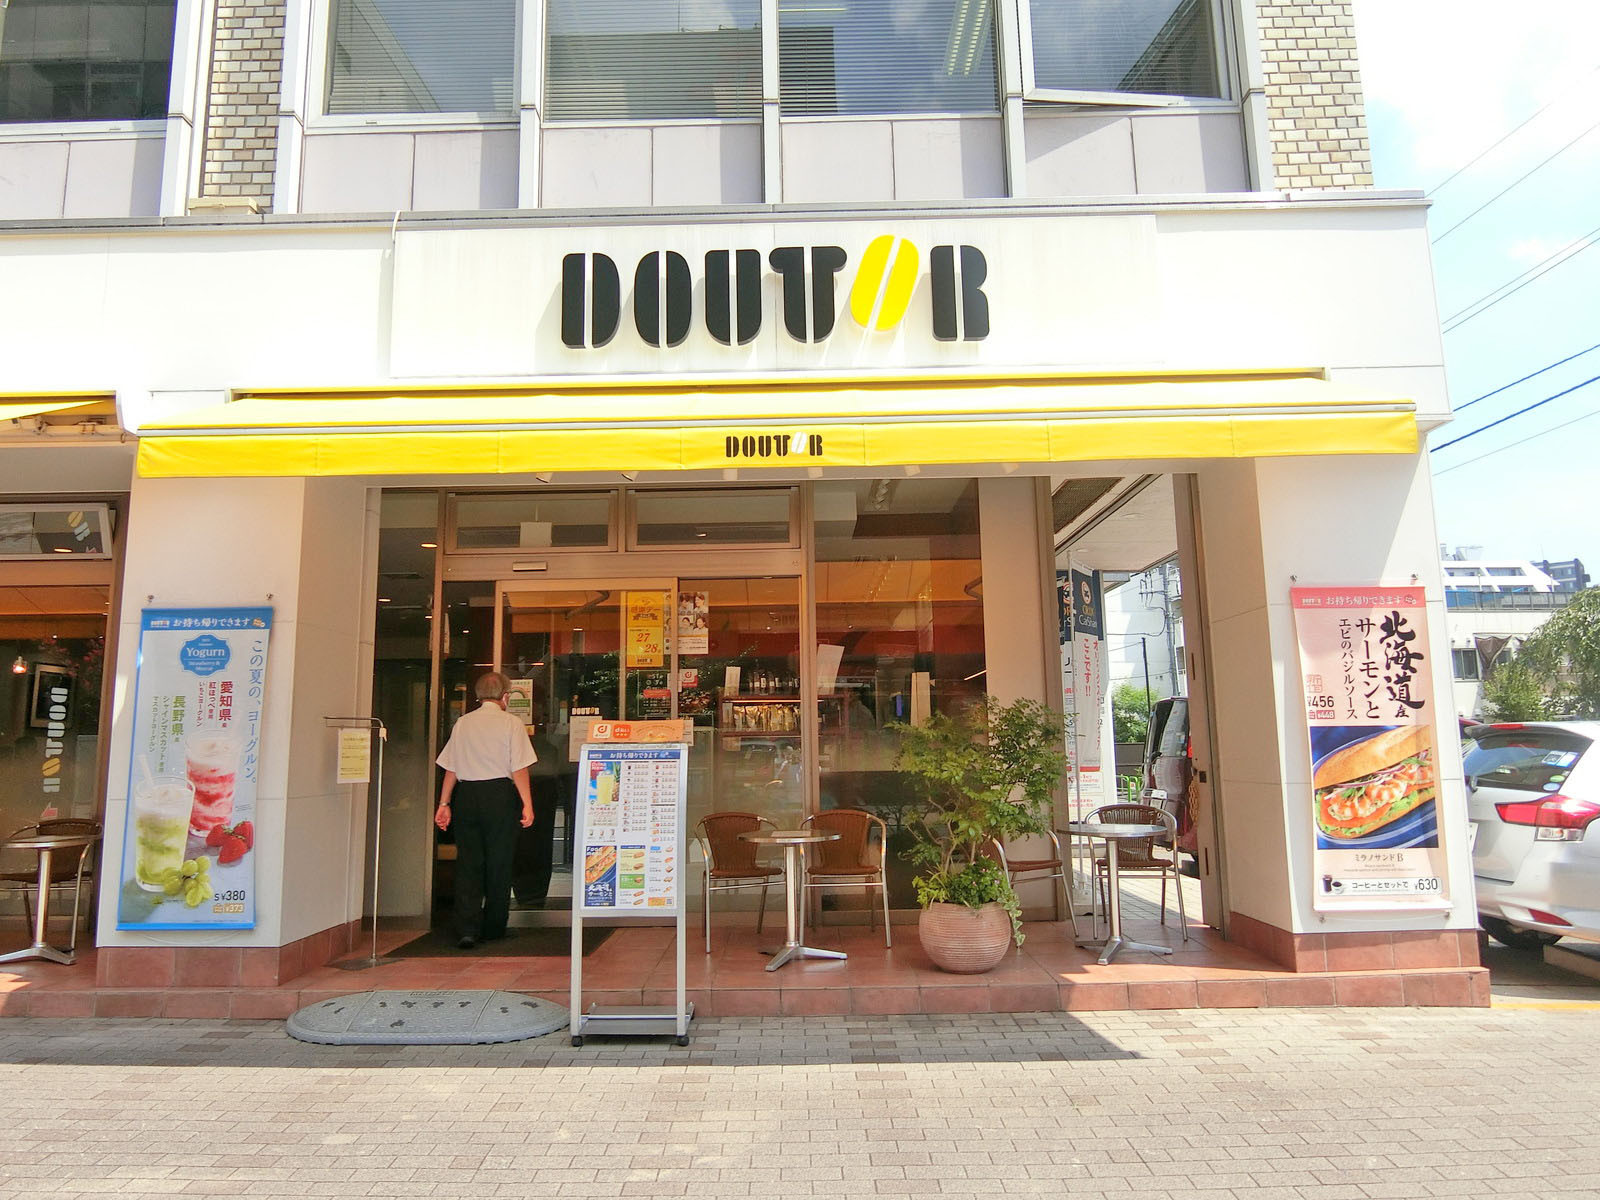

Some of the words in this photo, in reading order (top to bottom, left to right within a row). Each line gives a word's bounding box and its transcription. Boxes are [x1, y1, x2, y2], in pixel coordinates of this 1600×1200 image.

[561, 234, 991, 350] DOUTOR
[725, 431, 823, 458] DOUTOR
[1326, 595, 1402, 606] お持ち帰りできます
[173, 617, 250, 628] お持ち帰りできます
[636, 633, 650, 643] 27
[186, 647, 225, 658] Yogurn
[1339, 618, 1358, 720] エビのバジルソース
[1355, 617, 1380, 719] サーモンと
[1379, 610, 1425, 718] 北海道産
[243, 640, 264, 785] この夏の、ヨーグルン。
[571, 707, 600, 715] DOUTOR
[42, 687, 68, 793] DOUTOR
[1352, 881, 1409, 889] コーヒーとセットで
[1414, 877, 1438, 891] ¥630
[221, 890, 245, 901] ¥380
